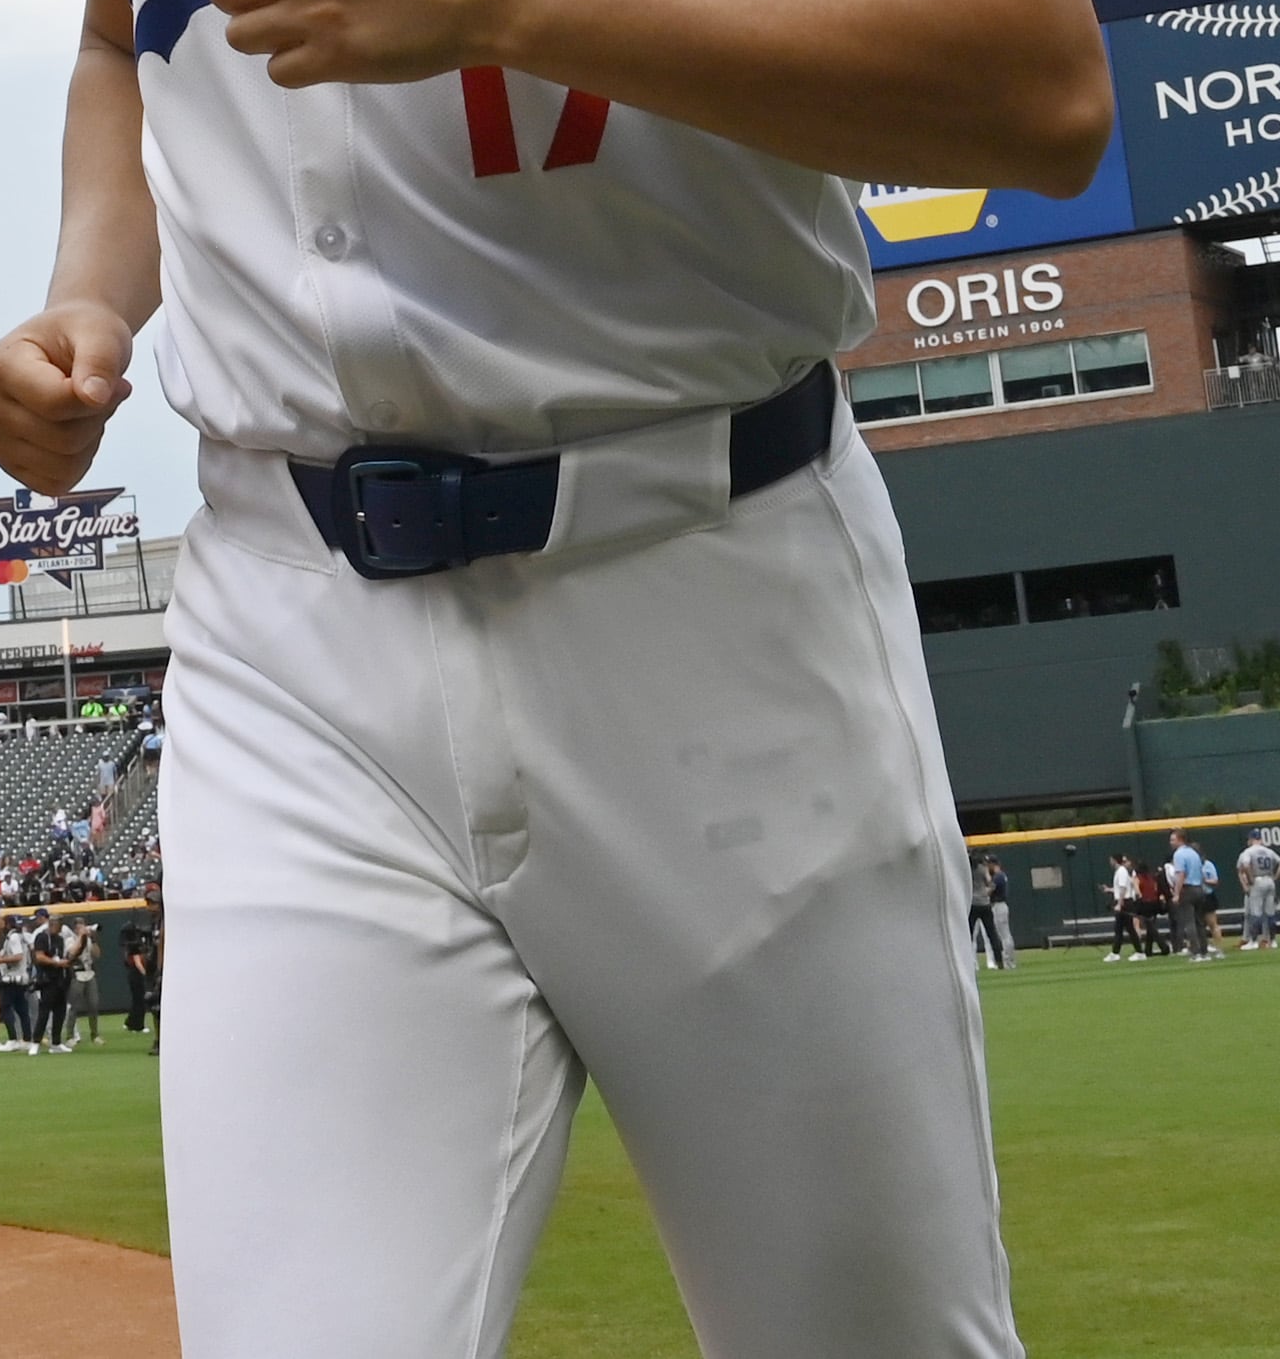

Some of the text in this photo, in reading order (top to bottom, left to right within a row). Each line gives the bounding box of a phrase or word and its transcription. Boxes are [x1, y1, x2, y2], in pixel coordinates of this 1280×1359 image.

[906, 262, 1064, 328] ORIS
[914, 317, 1065, 349] HÖLSTEIN 1904
[52, 506, 137, 548] Game
[37, 556, 94, 569] ATLANTA 2025
